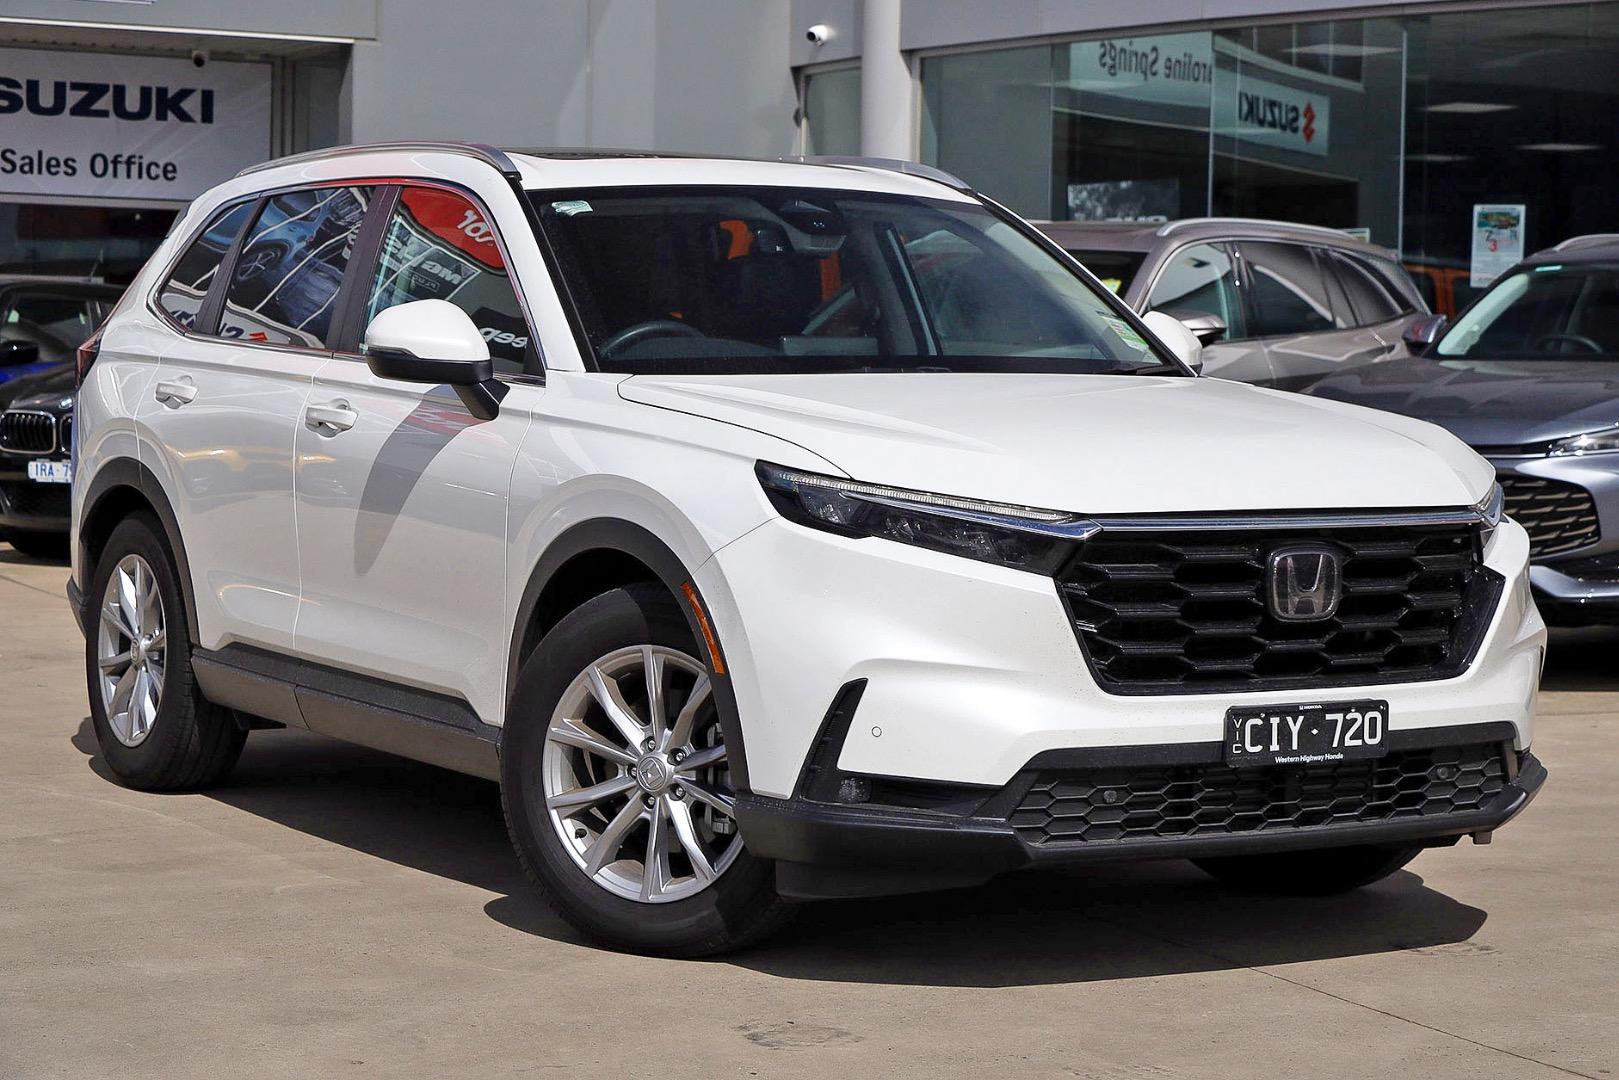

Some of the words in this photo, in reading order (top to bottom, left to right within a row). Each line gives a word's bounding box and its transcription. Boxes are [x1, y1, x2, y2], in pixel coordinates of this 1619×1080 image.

[0, 76, 214, 124] SUZUKI
[1, 148, 77, 177] Sales
[90, 153, 177, 182] Office
[1244, 715, 1305, 753] CIY
[1325, 710, 1383, 748] 720
[1274, 756, 1300, 764] Western
[1300, 754, 1325, 763] Highway
[1325, 752, 1344, 761] Honda
